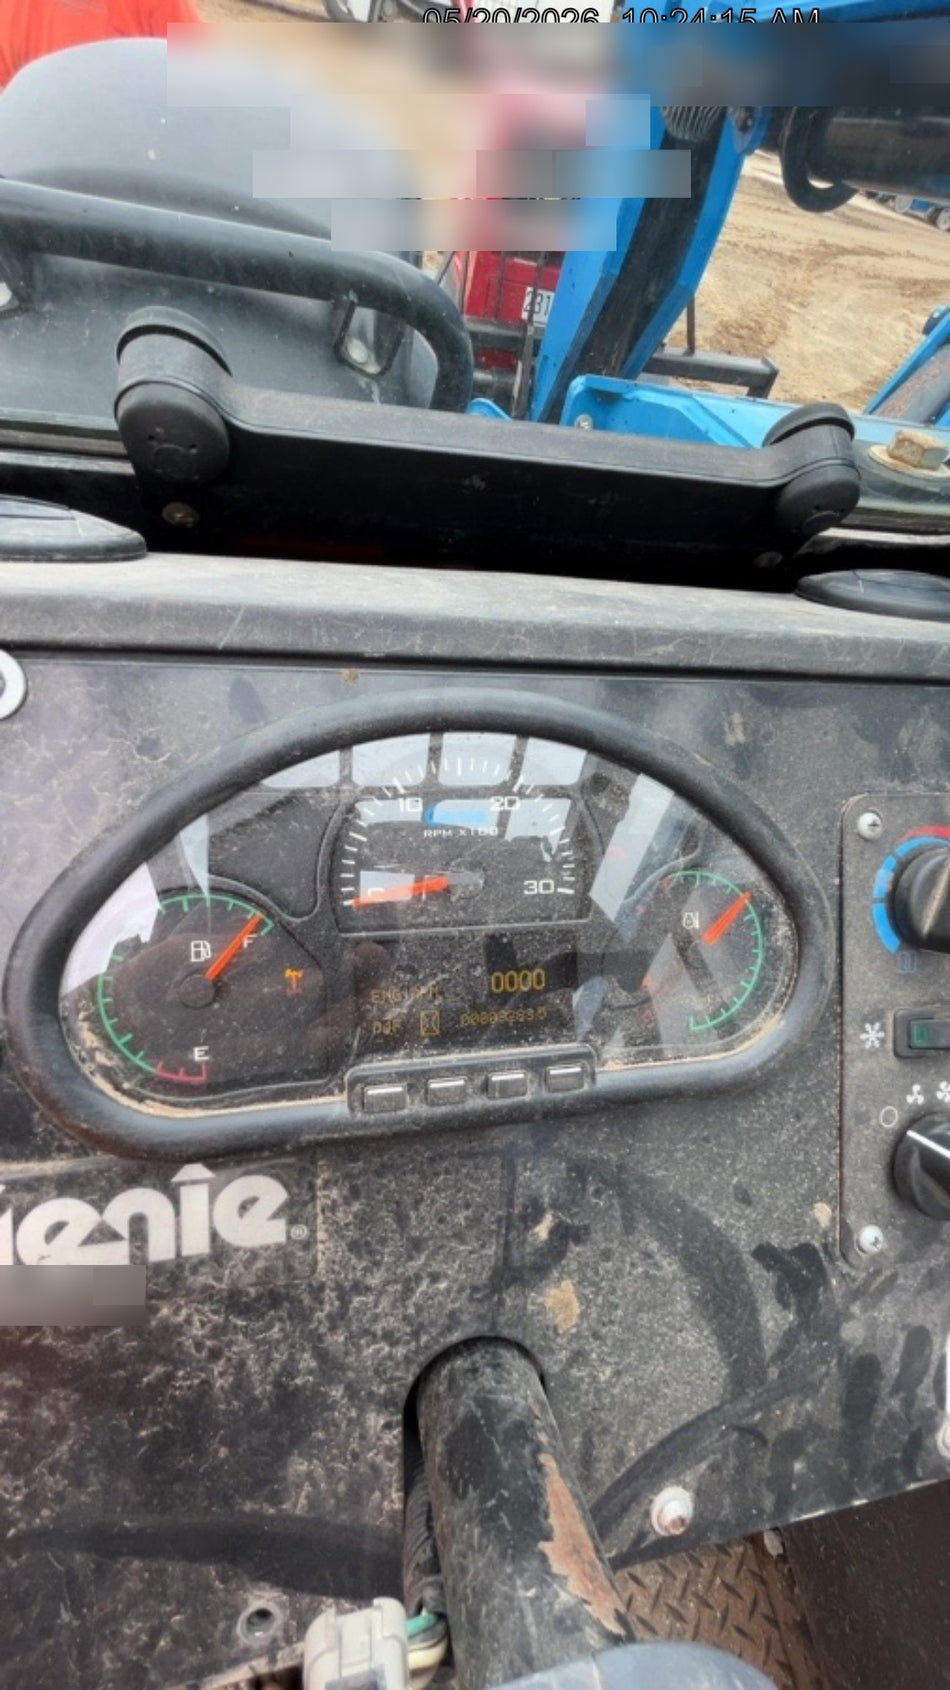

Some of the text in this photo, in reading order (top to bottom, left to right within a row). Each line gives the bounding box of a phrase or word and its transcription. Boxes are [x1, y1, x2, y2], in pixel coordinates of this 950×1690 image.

[399, 795, 521, 812] 10 20
[523, 879, 555, 895] 30
[243, 934, 257, 949] F
[491, 968, 546, 994] 0000
[194, 1046, 210, 1061] E
[0, 1163, 289, 1265] enie
